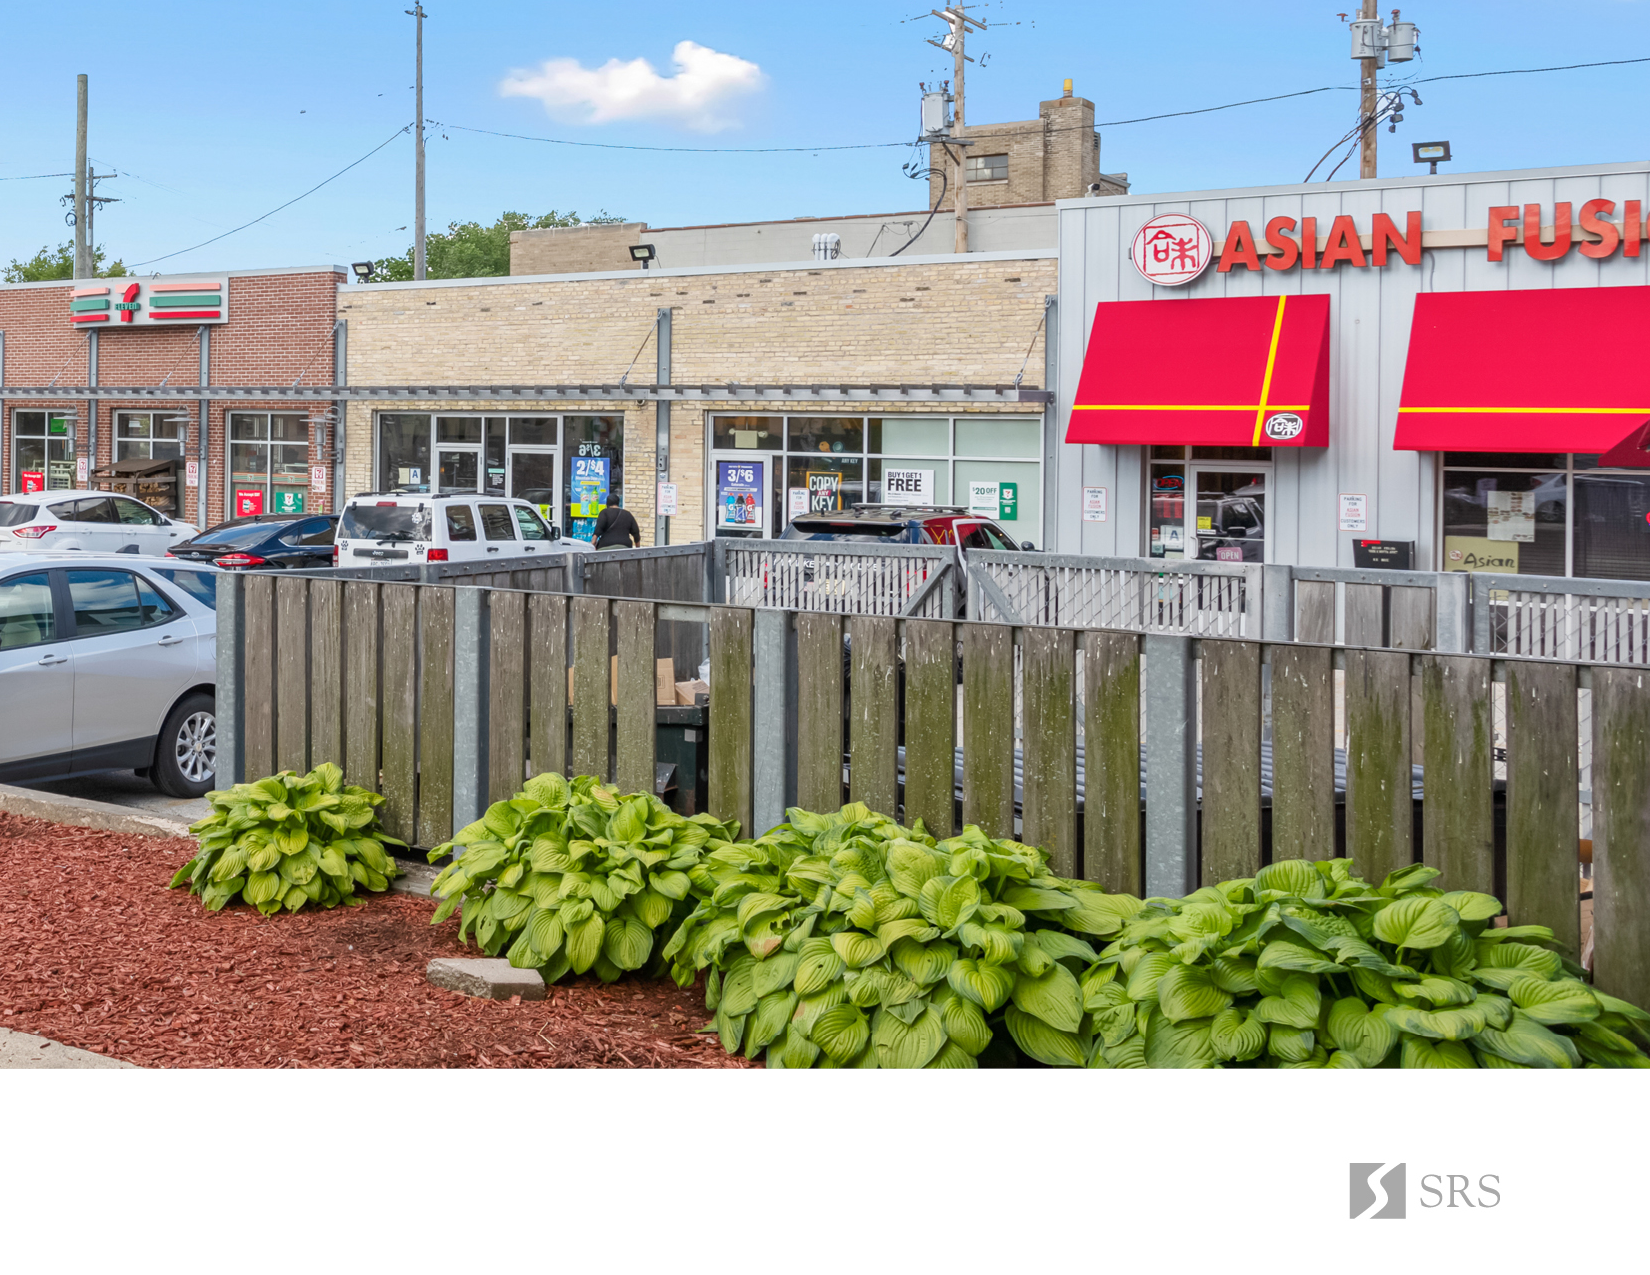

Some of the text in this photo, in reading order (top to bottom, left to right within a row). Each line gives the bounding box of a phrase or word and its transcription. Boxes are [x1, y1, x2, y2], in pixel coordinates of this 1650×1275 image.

[1216, 198, 1650, 273] ASIAN FUSI
[412, 470, 418, 478] A
[577, 460, 604, 476] 2/$4
[728, 469, 754, 482] 3/$6
[810, 476, 838, 491] COPY
[888, 479, 921, 492] FREE
[972, 487, 985, 495] $20
[812, 496, 834, 511] KEY
[1170, 530, 1180, 541] A
[1463, 553, 1515, 568] Asian
